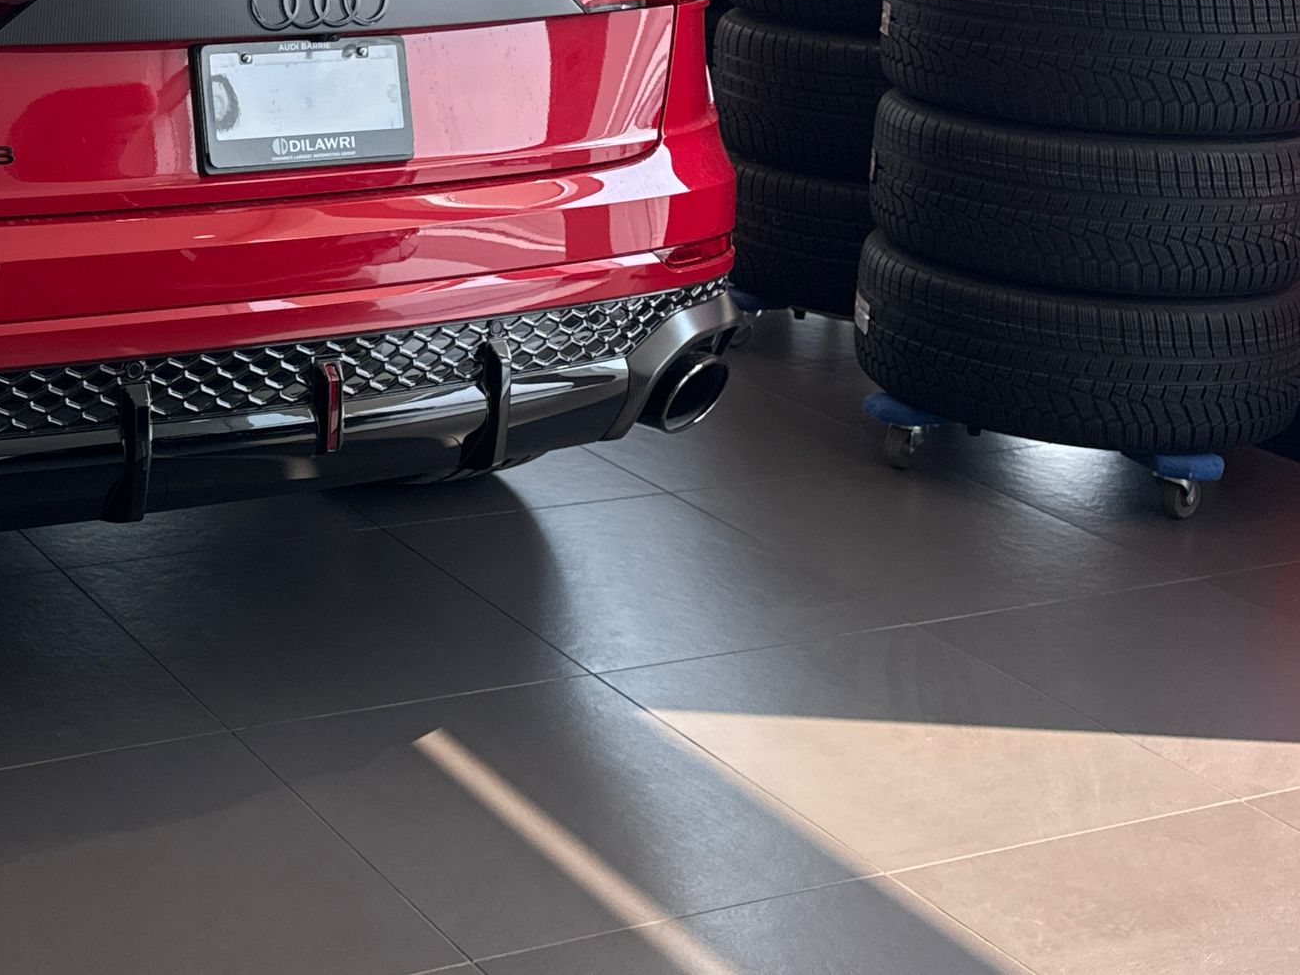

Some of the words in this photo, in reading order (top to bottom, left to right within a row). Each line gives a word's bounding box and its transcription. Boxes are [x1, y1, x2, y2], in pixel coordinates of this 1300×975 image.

[278, 43, 299, 52] AUDI
[300, 42, 332, 50] BARRIE
[289, 135, 355, 152] DILAWRI
